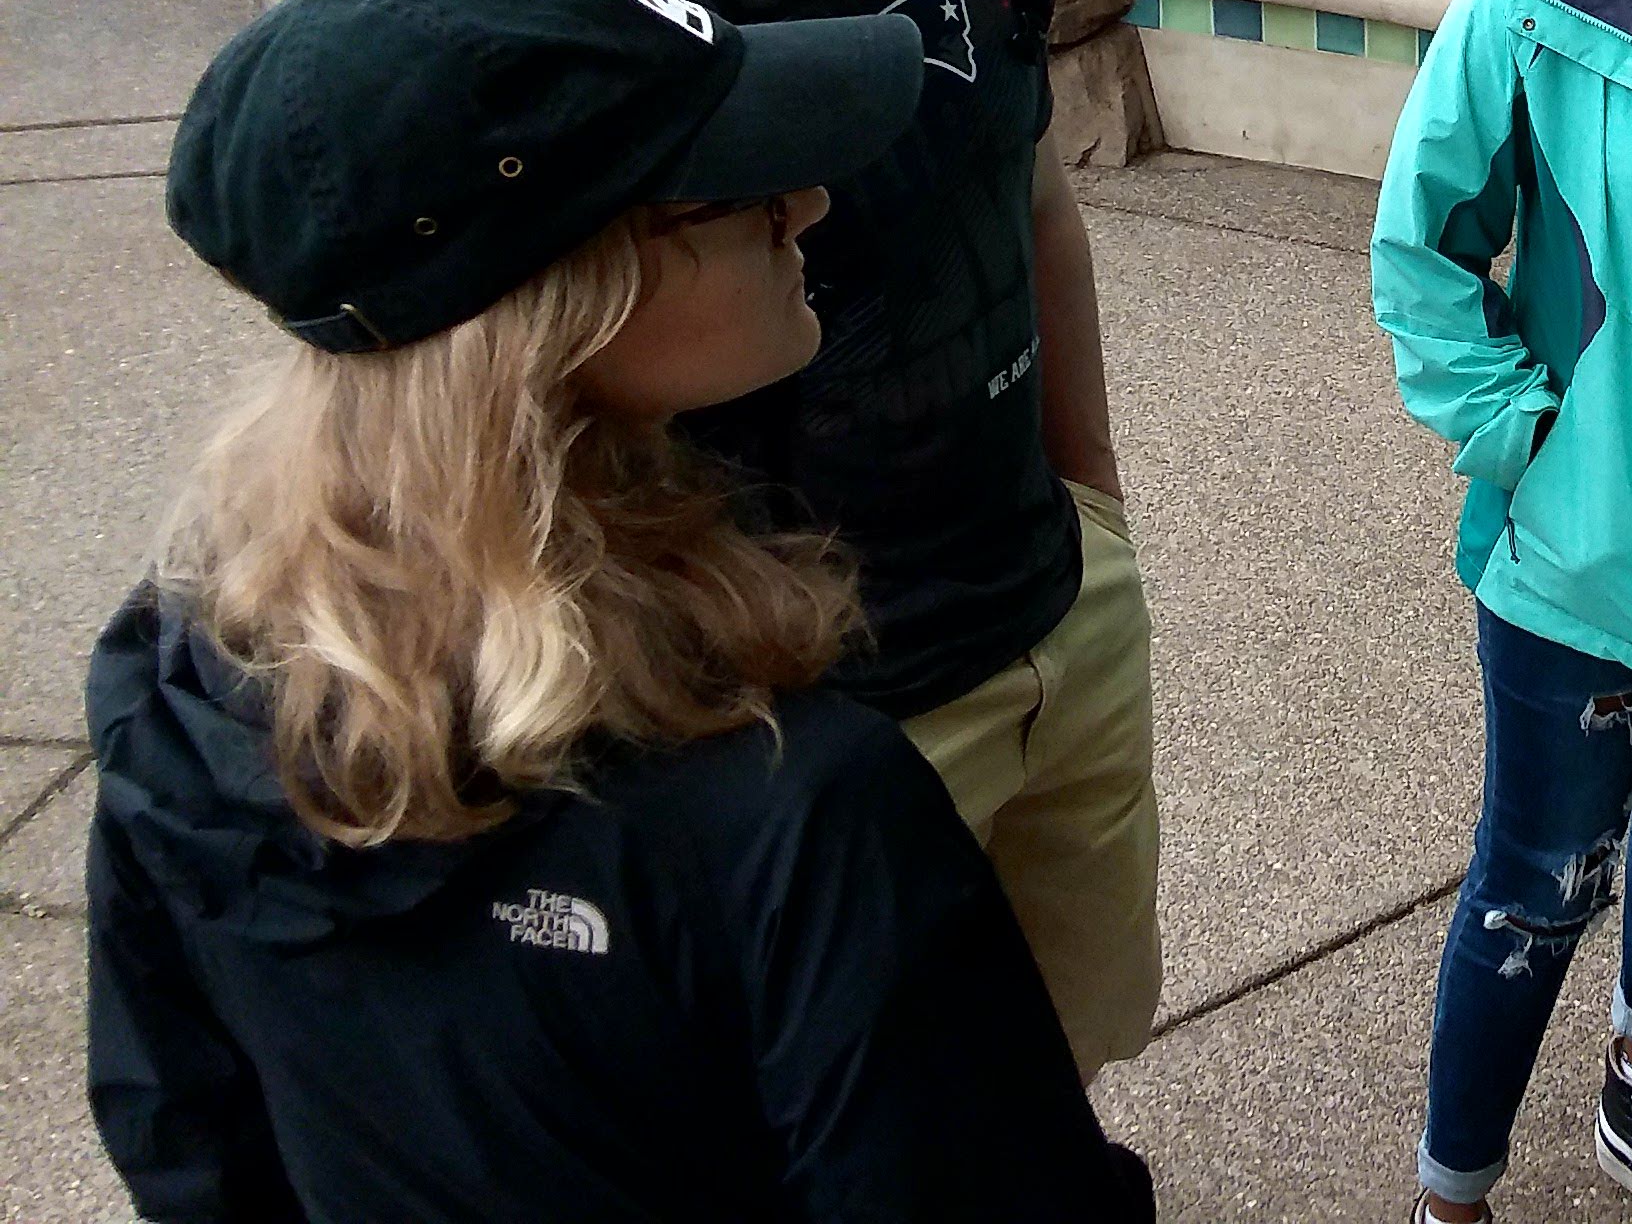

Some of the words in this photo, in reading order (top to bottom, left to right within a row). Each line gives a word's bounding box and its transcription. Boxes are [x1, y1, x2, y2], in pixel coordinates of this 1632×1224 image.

[987, 370, 1009, 400] WE
[1011, 348, 1032, 383] ARE
[527, 888, 572, 913] THE
[492, 901, 570, 935] NORTH
[510, 924, 569, 948] FACE
